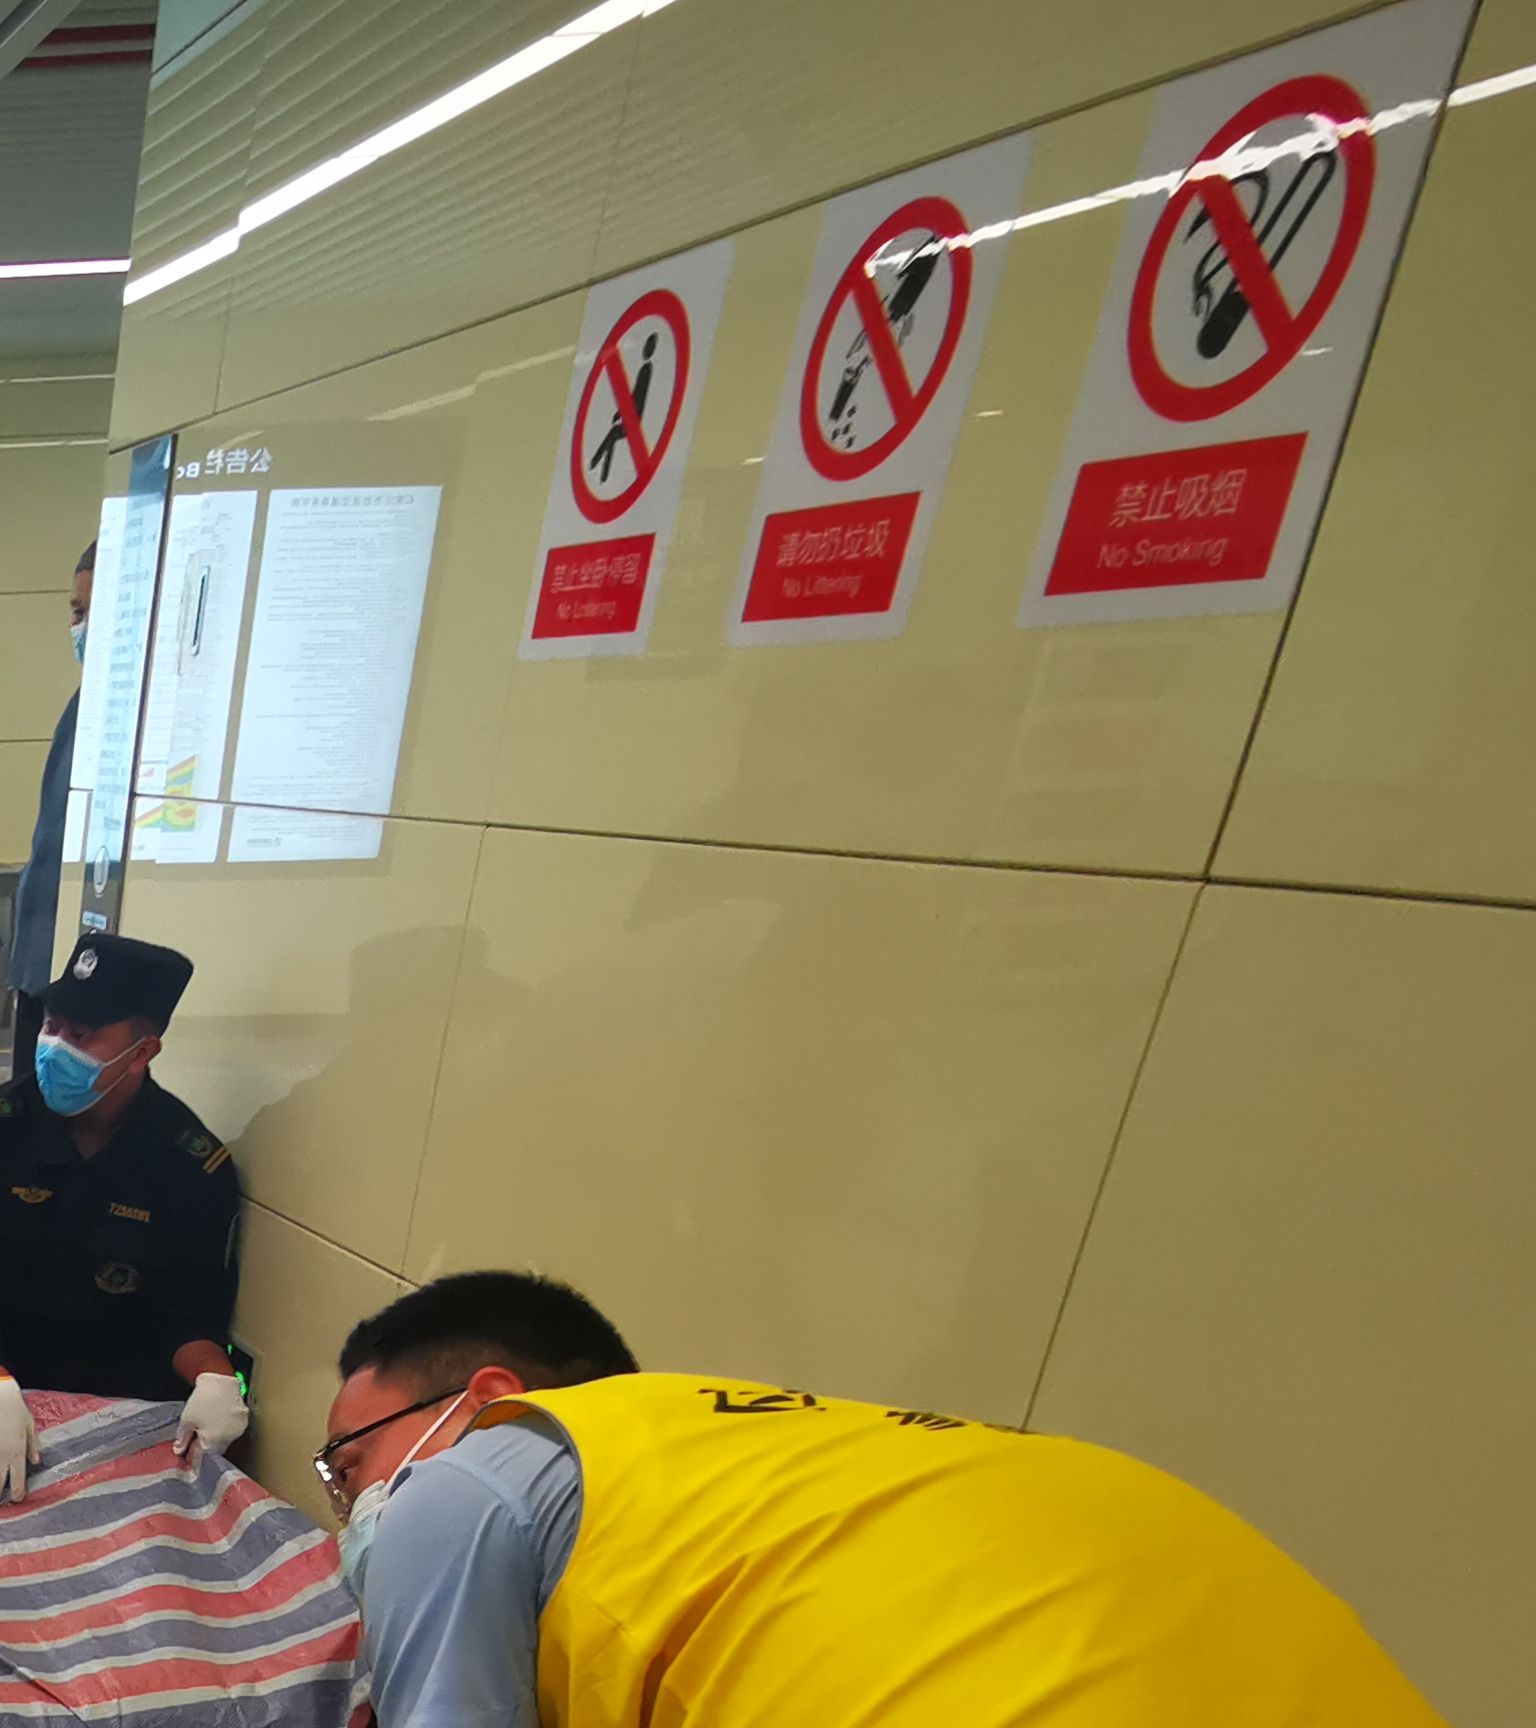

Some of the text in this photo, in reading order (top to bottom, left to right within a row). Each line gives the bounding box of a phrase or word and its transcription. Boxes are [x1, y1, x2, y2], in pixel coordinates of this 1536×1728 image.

[1108, 468, 1247, 527] 禁止吸烟
[776, 520, 891, 567] 请勿扔垃圾
[1096, 537, 1227, 569] No Smoking
[782, 577, 801, 598] No
